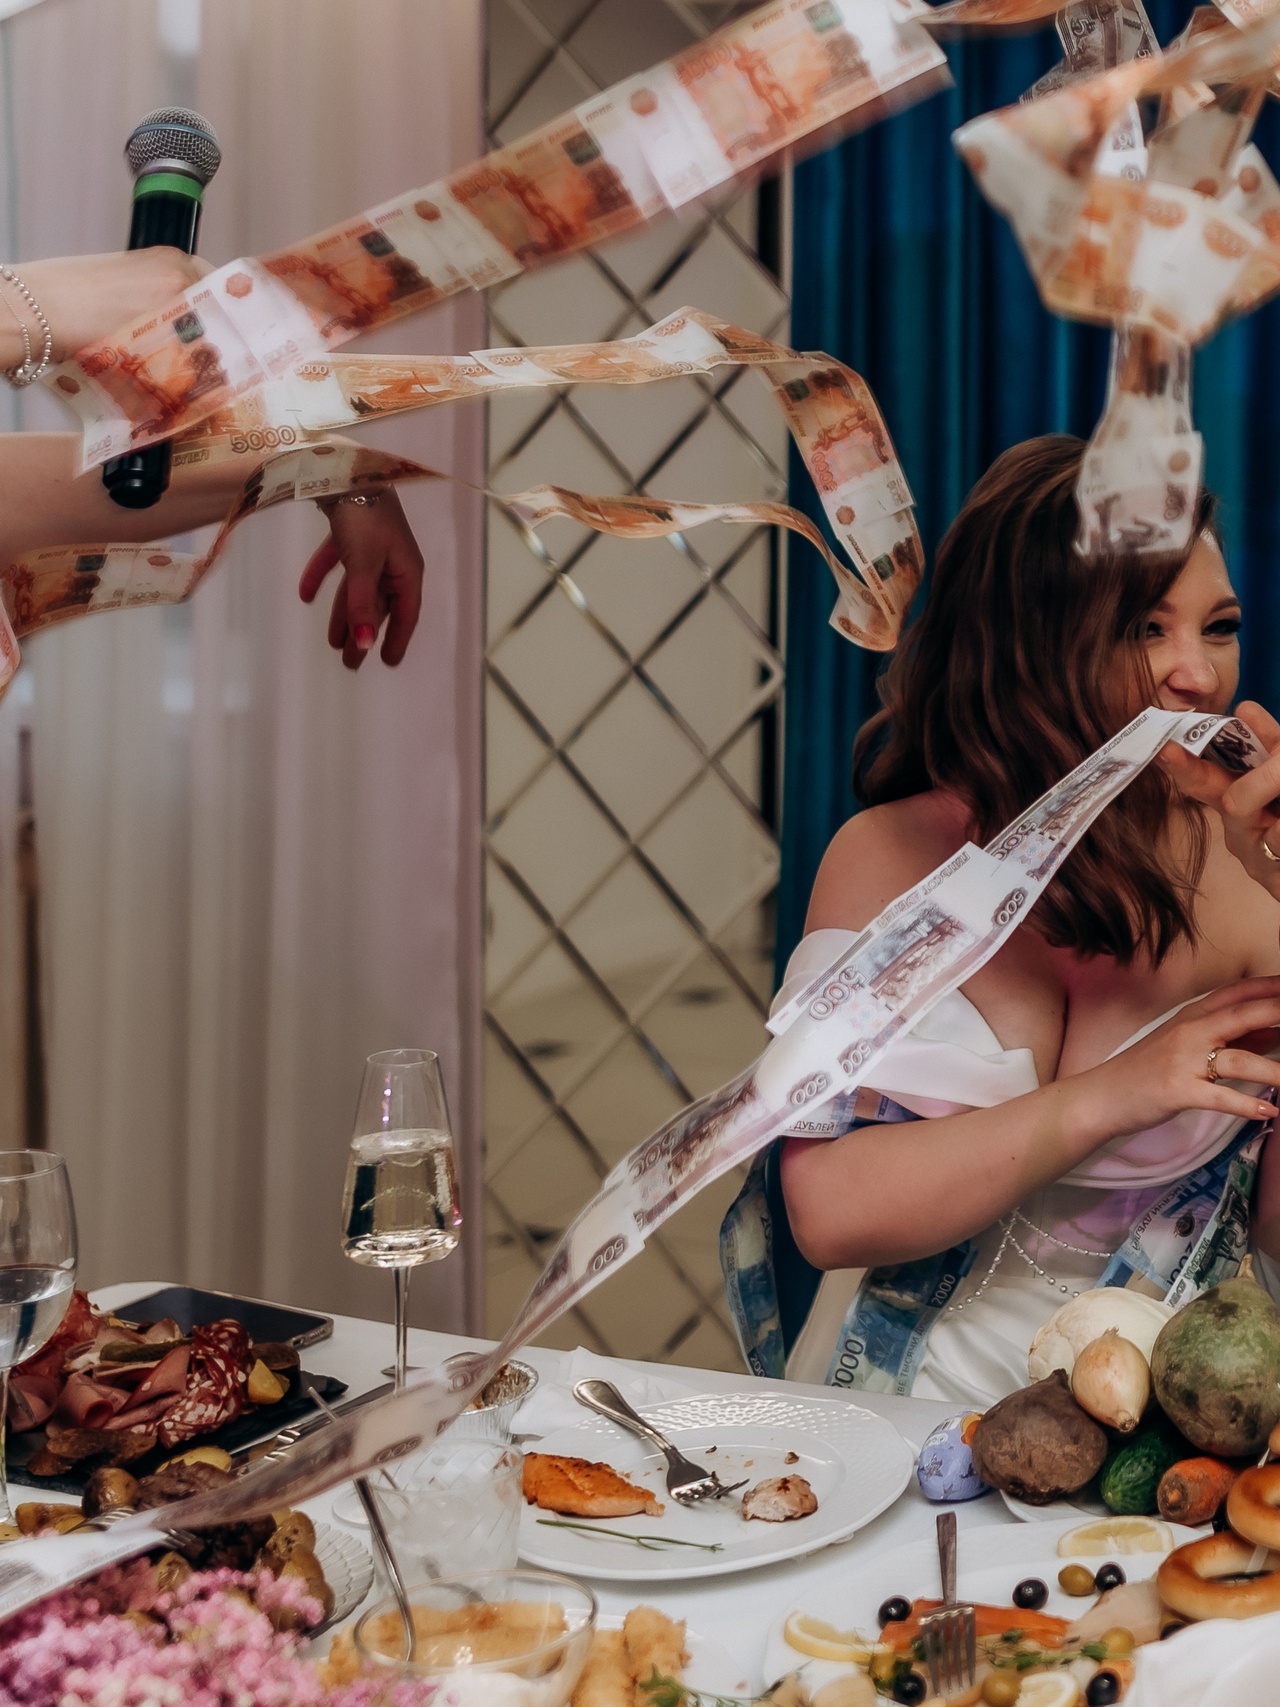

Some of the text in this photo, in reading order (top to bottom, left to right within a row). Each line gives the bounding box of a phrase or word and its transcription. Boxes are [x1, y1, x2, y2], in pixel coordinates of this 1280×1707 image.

[231, 425, 297, 454] 5000
[997, 889, 1025, 927] 500
[808, 965, 868, 1021] 500
[841, 1040, 873, 1076] 500
[790, 1073, 829, 1106] 500
[592, 1237, 626, 1273] 500
[931, 1273, 956, 1306] 2000
[901, 1336, 919, 1378] ТЫСЯЧИ
